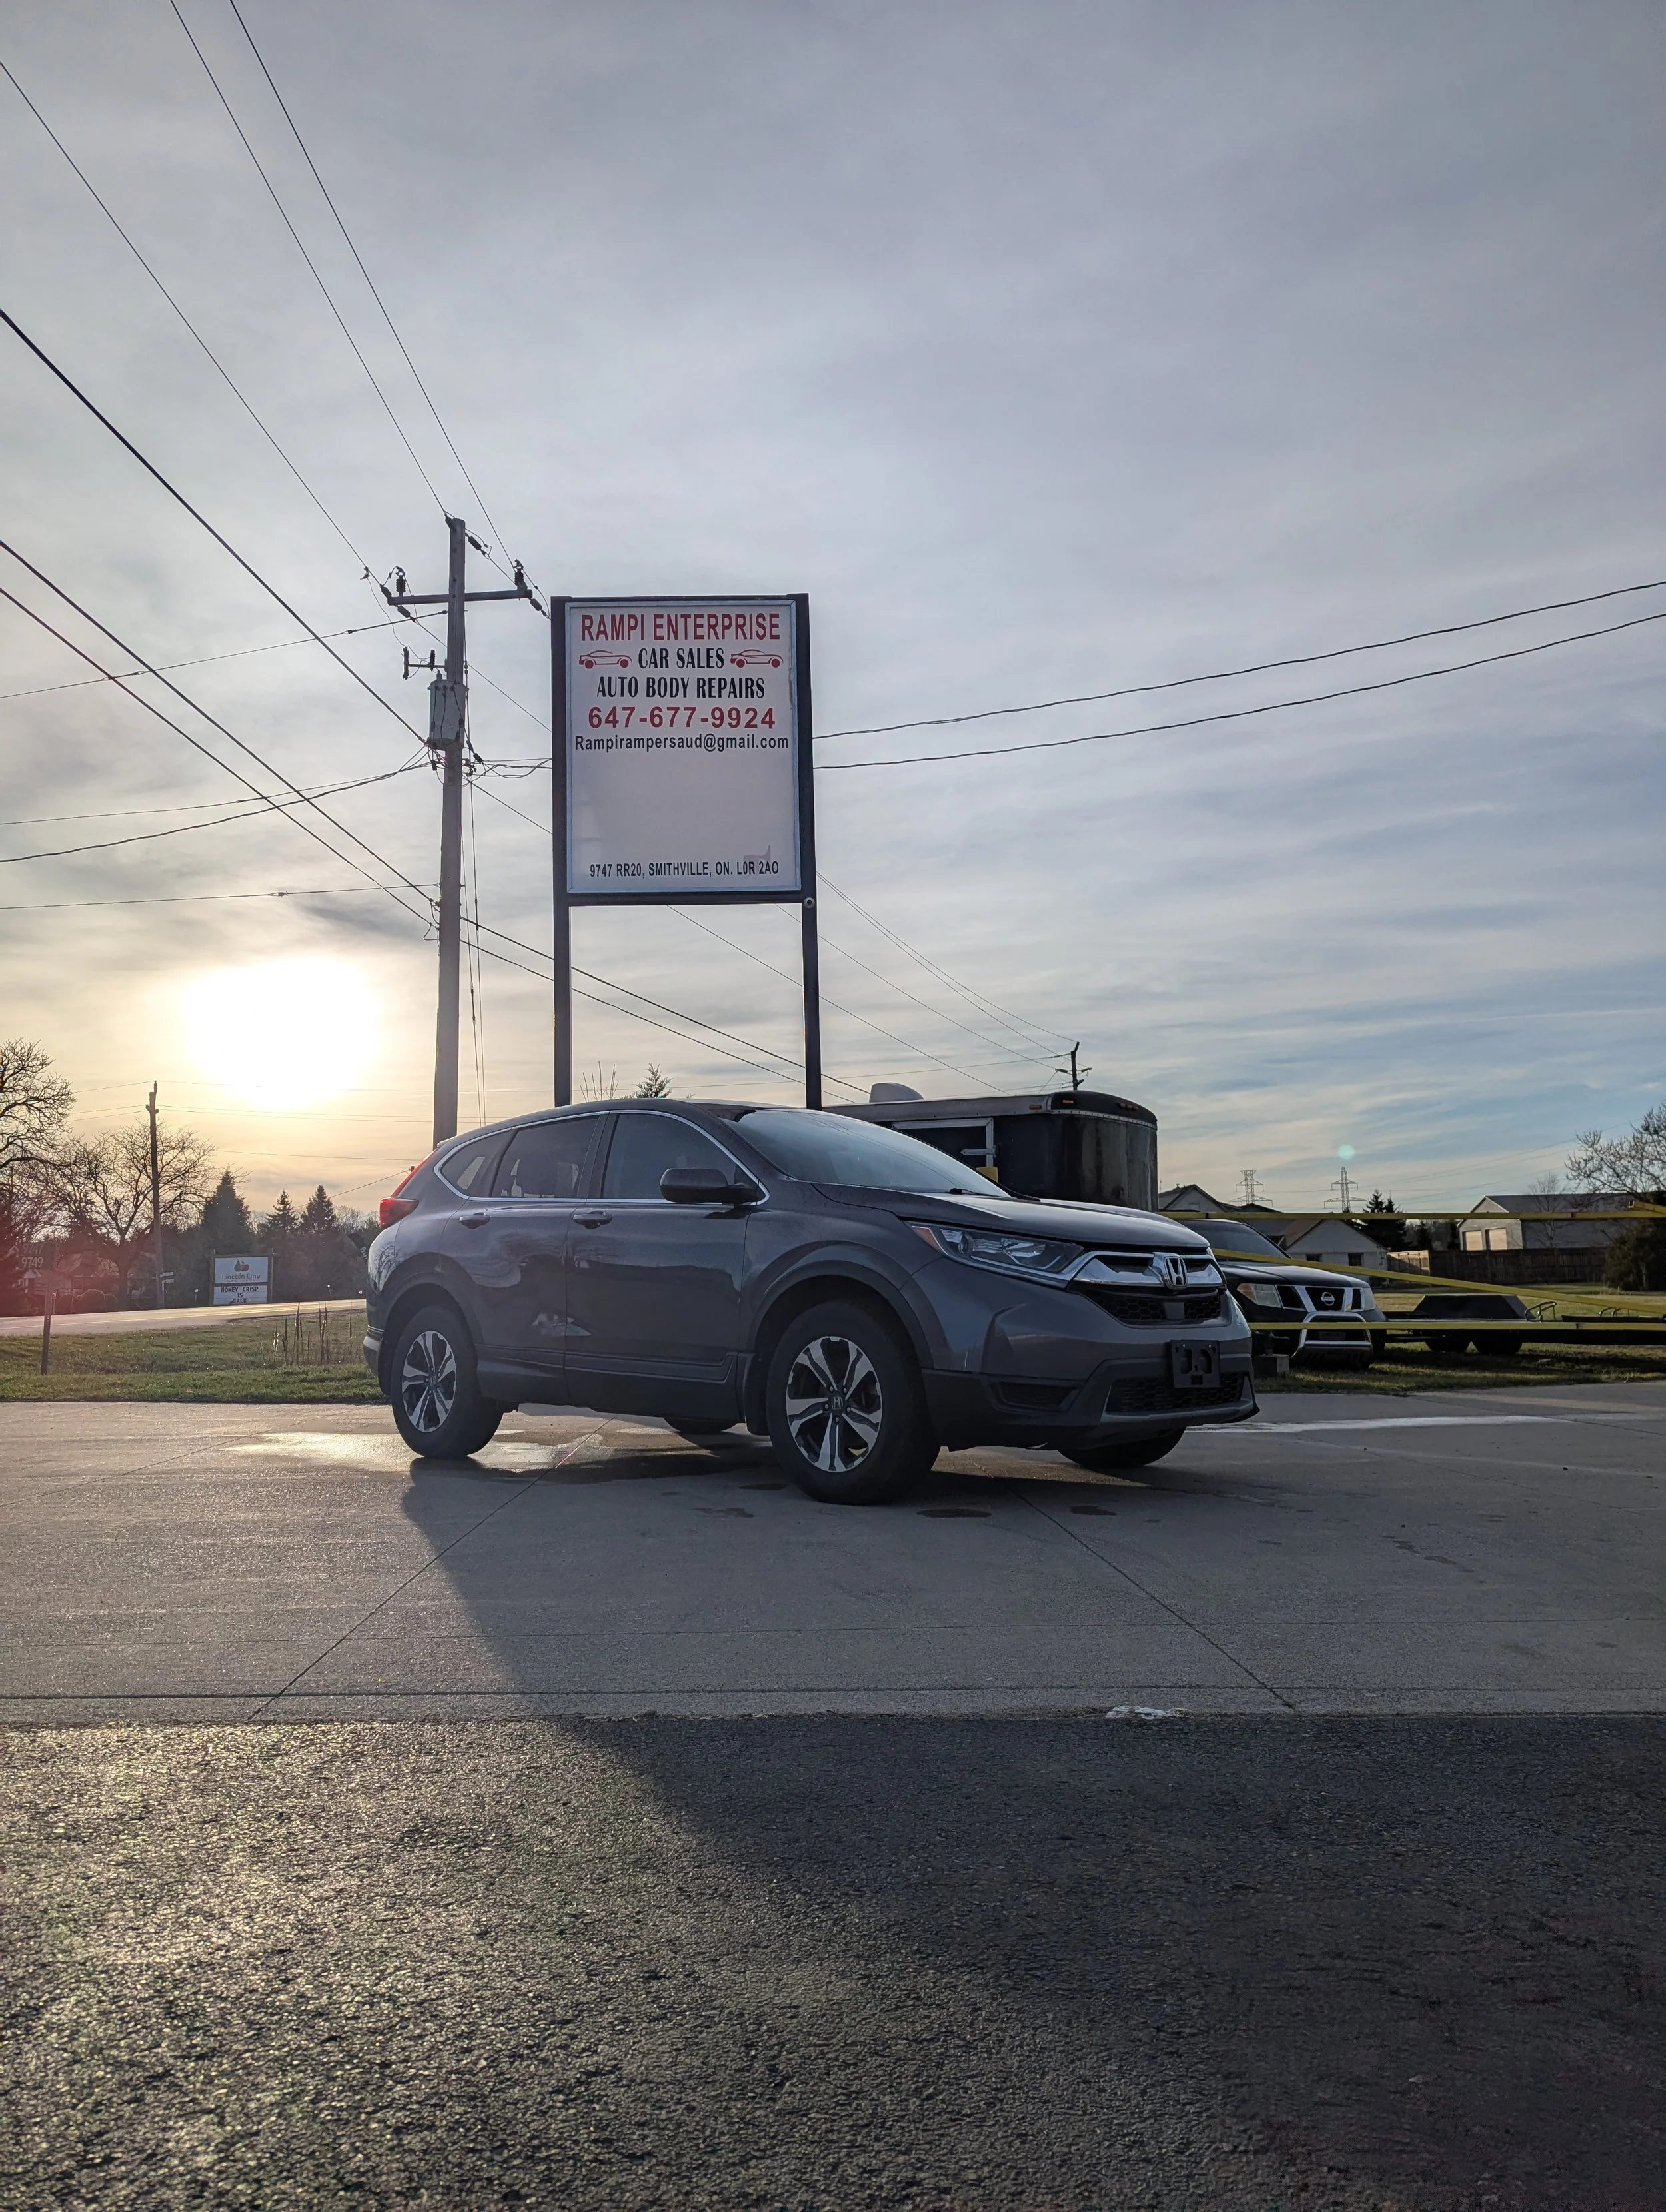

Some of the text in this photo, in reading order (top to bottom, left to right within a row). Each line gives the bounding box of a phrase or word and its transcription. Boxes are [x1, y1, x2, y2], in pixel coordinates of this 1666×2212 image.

[582, 613, 780, 641] RAMPI ENTERPRISE
[638, 647, 725, 669] CAR SALES
[596, 676, 765, 699] AUTO BODY REPAIRS
[588, 706, 776, 730] 647-677-9924
[575, 733, 788, 752] Rampirampersaud@gmail.com
[590, 863, 612, 877] 9747
[616, 863, 645, 879] RR20,
[648, 861, 712, 878] SMITHVILLE,
[715, 861, 733, 875] ON.
[21, 1257, 43, 1268] 9749
